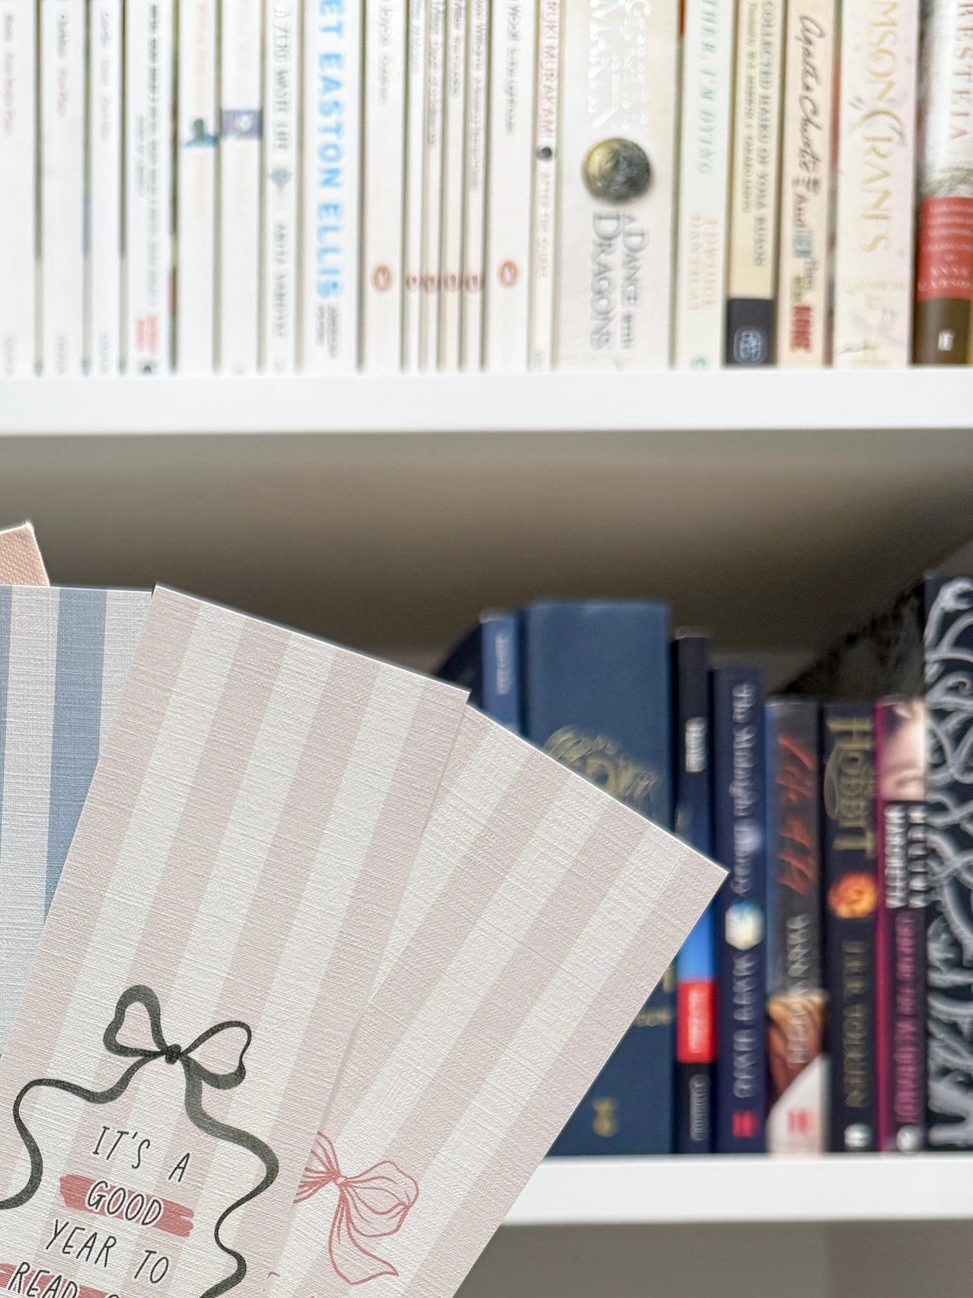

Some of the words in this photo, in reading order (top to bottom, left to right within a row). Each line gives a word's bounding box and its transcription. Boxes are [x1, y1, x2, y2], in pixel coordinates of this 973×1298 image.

[795, 16, 828, 92] Agatha
[316, 52, 345, 188] EASTON
[797, 95, 825, 175] Christie
[315, 202, 345, 299] ELLIS
[590, 211, 622, 351] DRAGONS
[826, 716, 876, 858] HOBBIT
[92, 1126, 150, 1169] IT'S
[168, 1152, 190, 1182] A
[87, 1180, 163, 1226] GOOD
[45, 1218, 117, 1268] YEAR
[134, 1250, 169, 1284] TO
